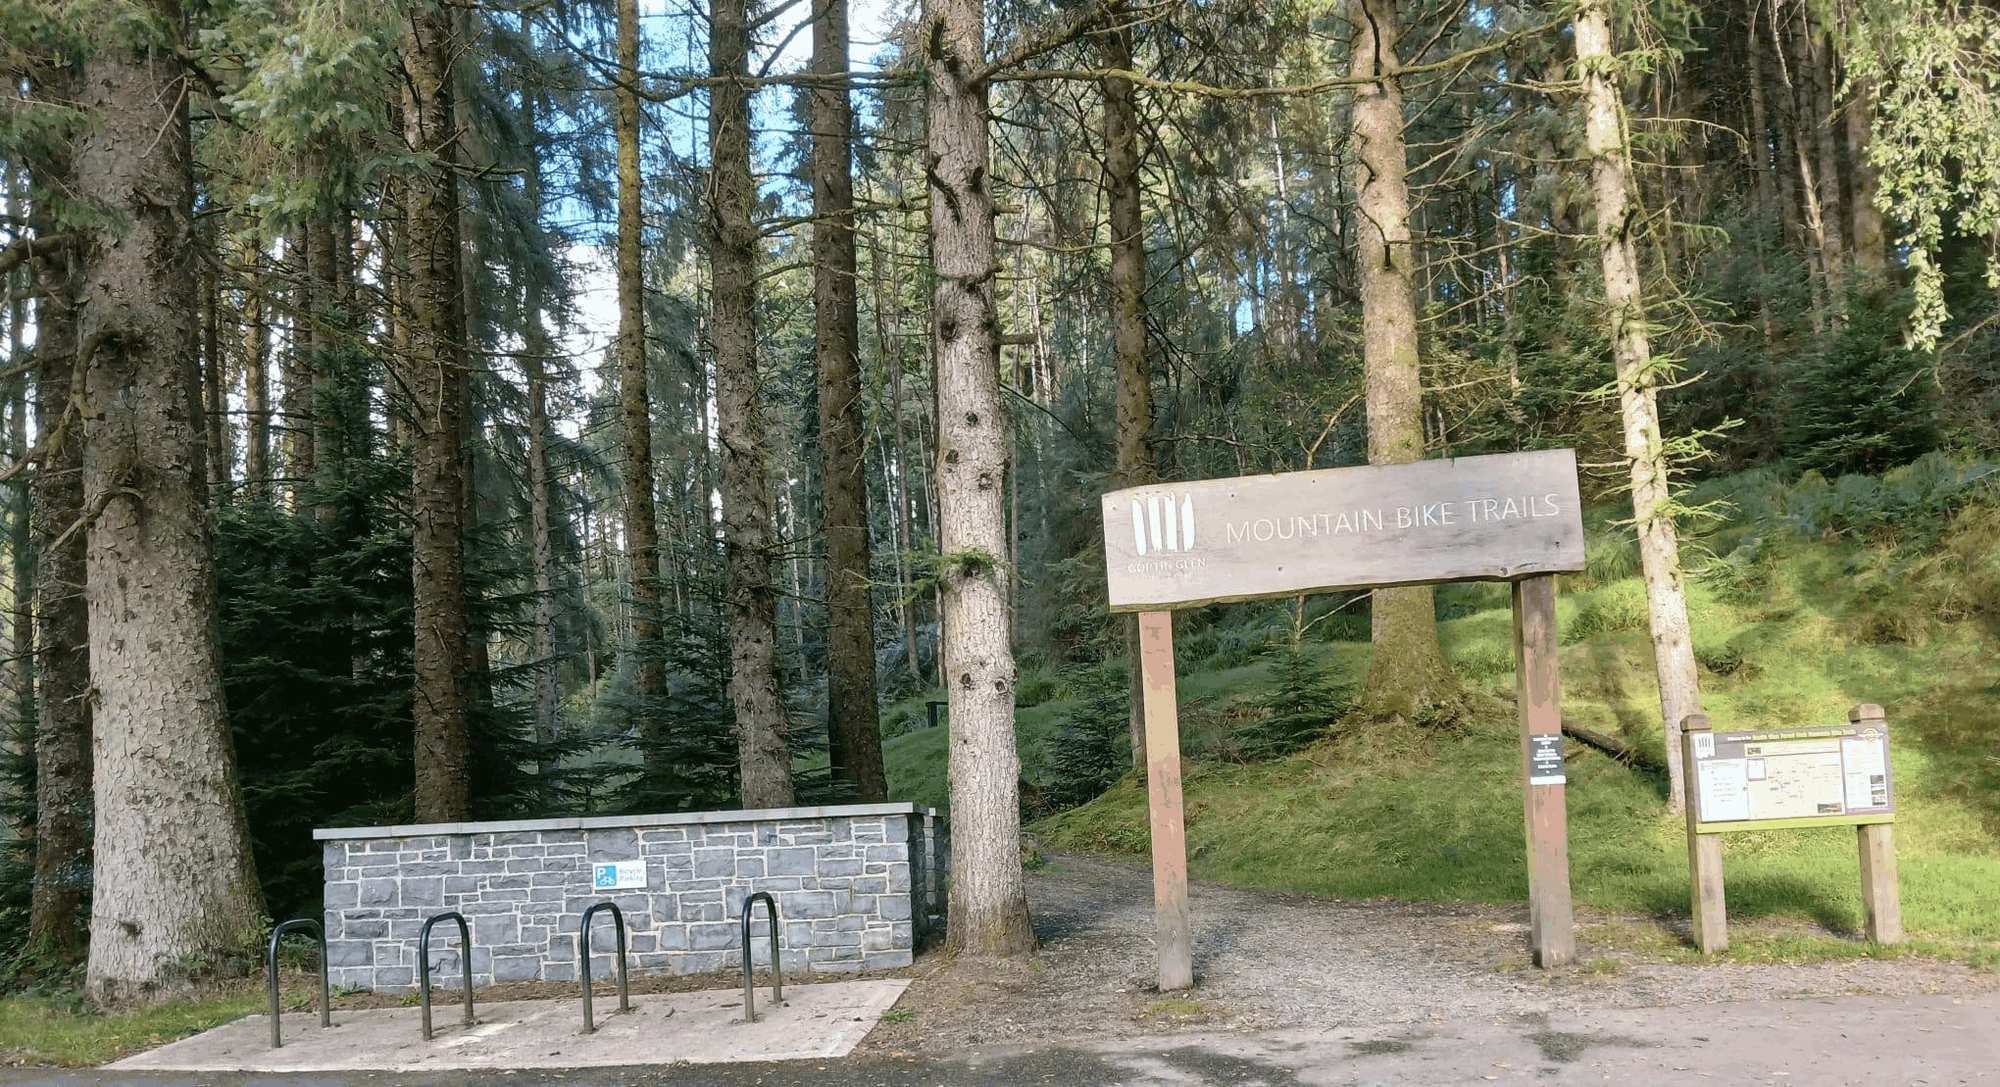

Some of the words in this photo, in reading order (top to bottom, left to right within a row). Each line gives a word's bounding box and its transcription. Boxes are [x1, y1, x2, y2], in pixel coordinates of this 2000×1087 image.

[1226, 509, 1383, 543] MOUNTAIN
[1396, 502, 1457, 529] BIKE
[1466, 493, 1560, 523] TRAILS
[597, 867, 606, 879] P
